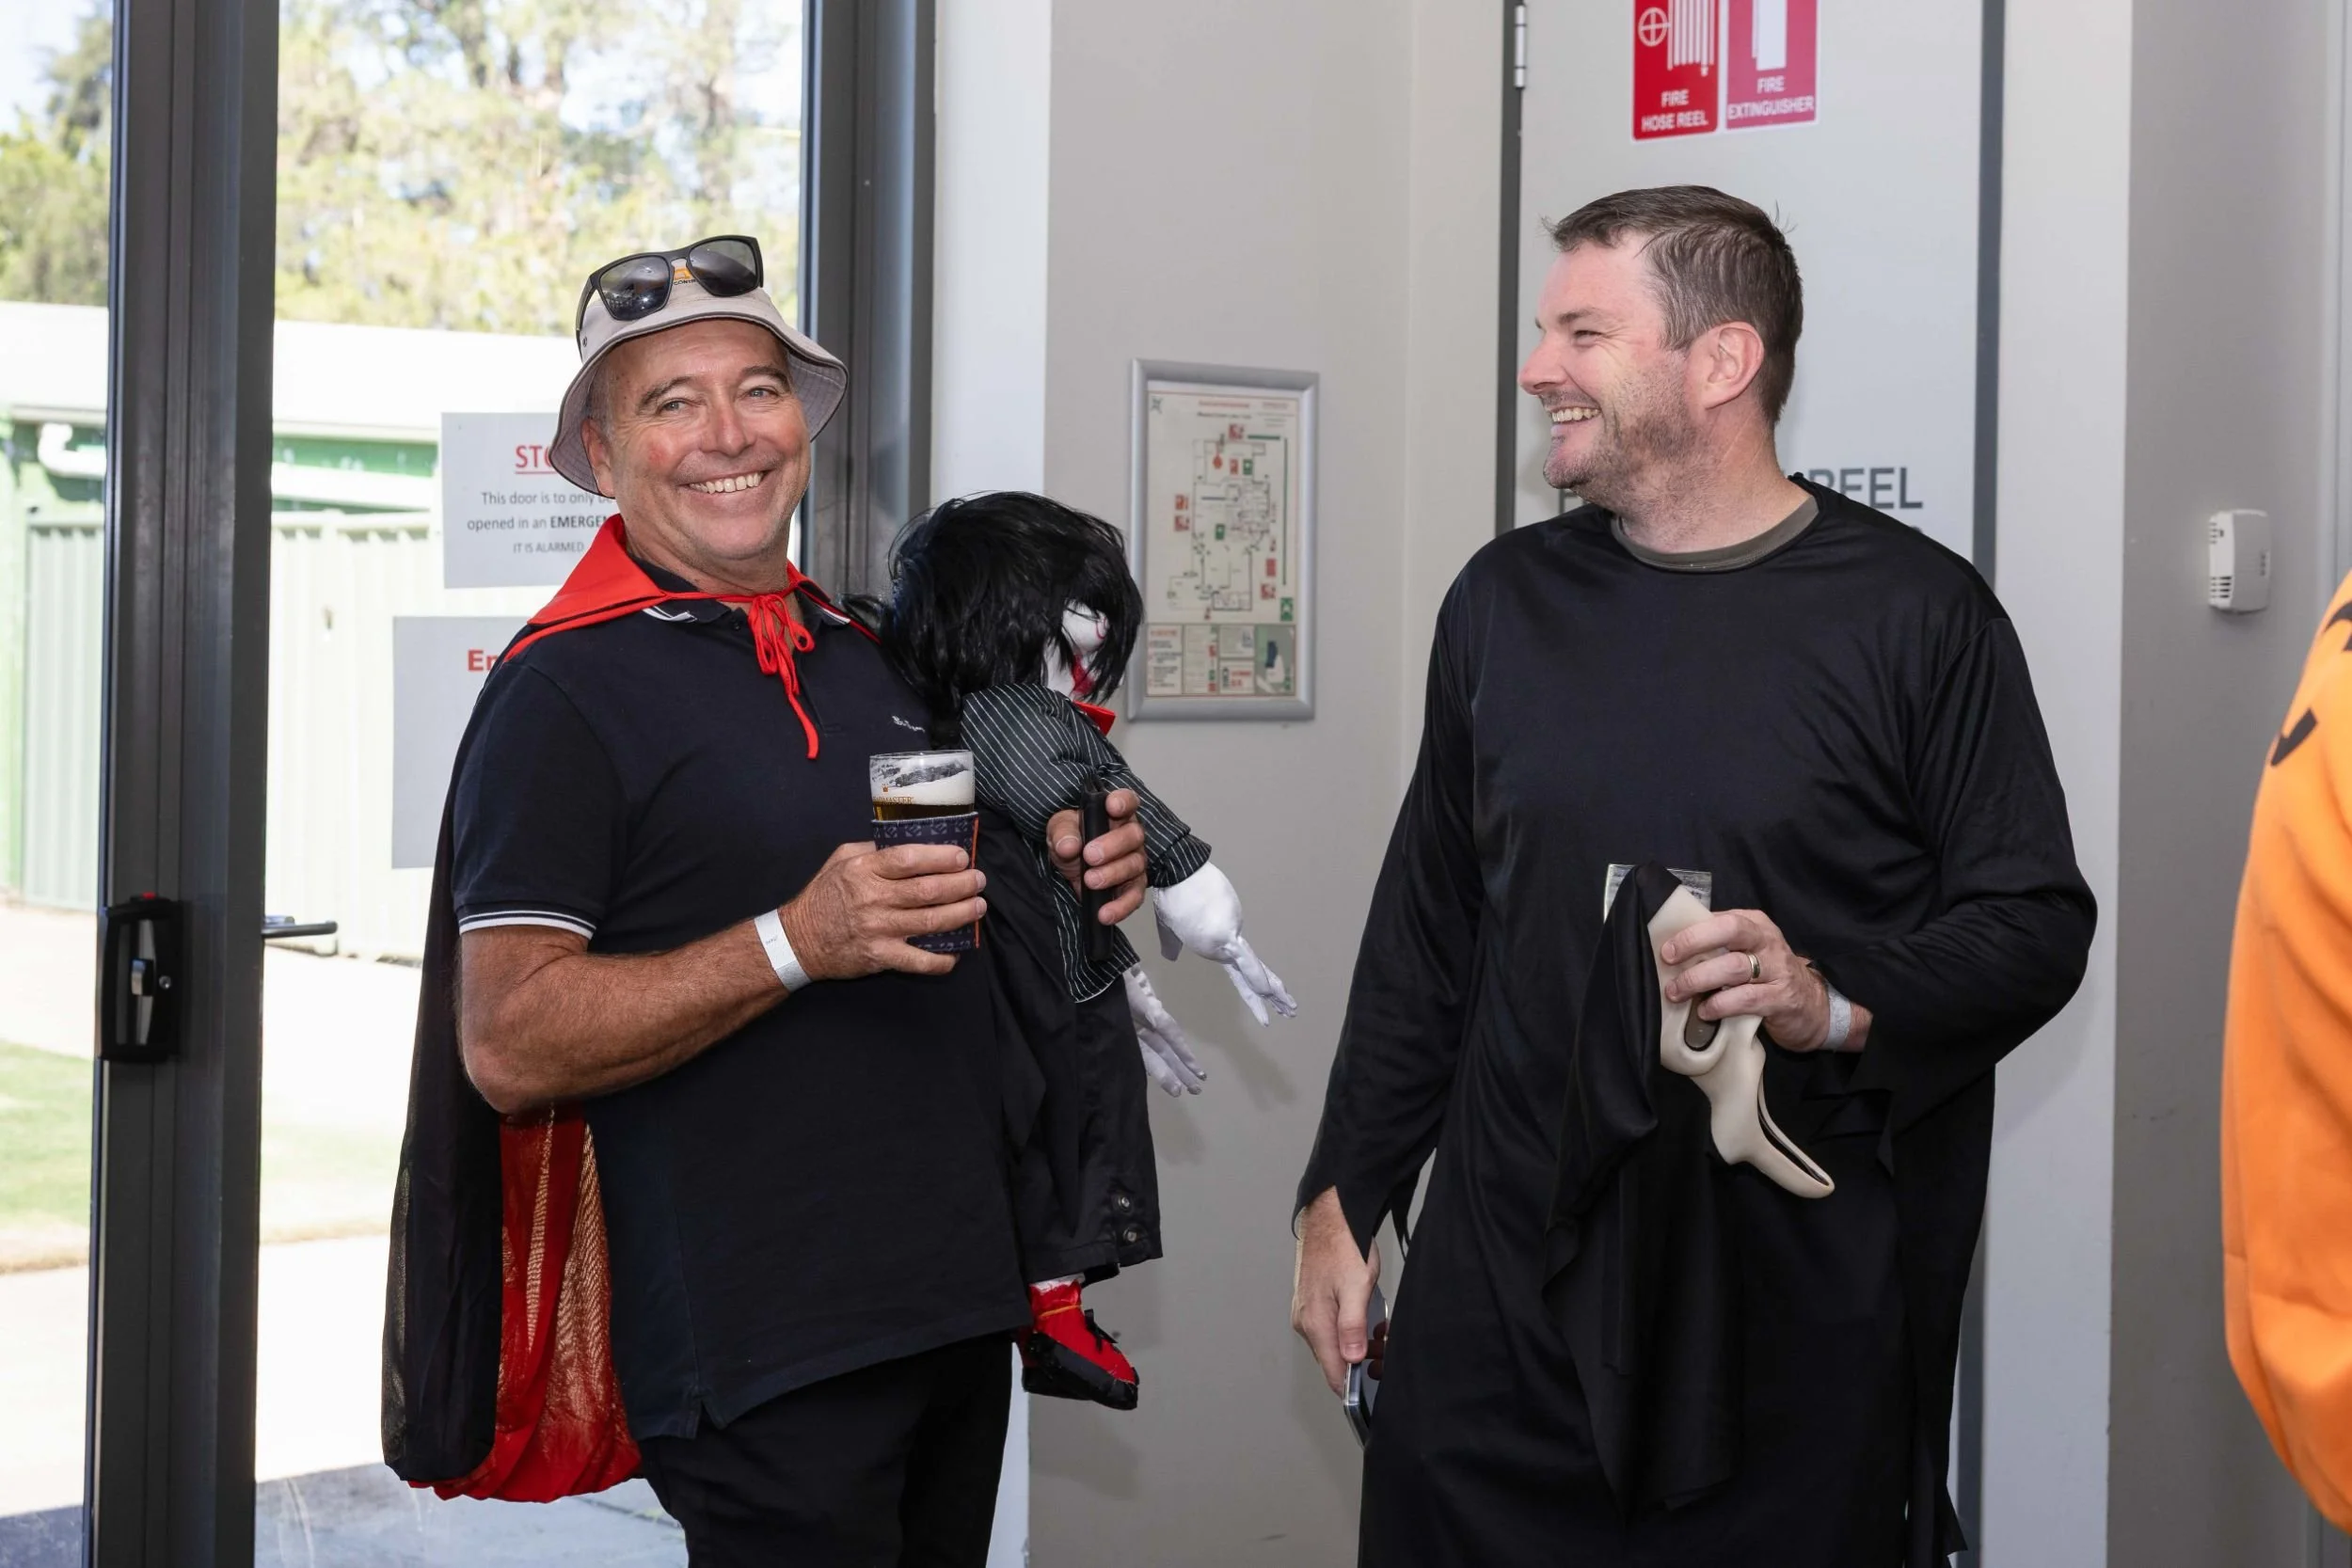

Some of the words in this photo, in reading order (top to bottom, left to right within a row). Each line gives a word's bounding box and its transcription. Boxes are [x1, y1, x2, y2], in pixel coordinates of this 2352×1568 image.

[1756, 75, 1786, 93] FIRE
[1661, 88, 1690, 108] FIRE
[1727, 95, 1815, 120] EXTINGUISHER
[1641, 113, 1676, 132] HOSE
[1677, 109, 1709, 128] REEL
[516, 445, 552, 468] ST
[481, 491, 506, 505] This
[509, 490, 537, 505] door
[541, 491, 550, 504] is
[553, 493, 565, 504] to
[569, 492, 595, 507] only
[467, 515, 515, 532] opened
[518, 517, 529, 530] in
[532, 517, 547, 530] an
[550, 515, 607, 529] EMERGE
[513, 542, 522, 554] IT
[525, 542, 533, 554] IS
[535, 541, 585, 554] ALARMED
